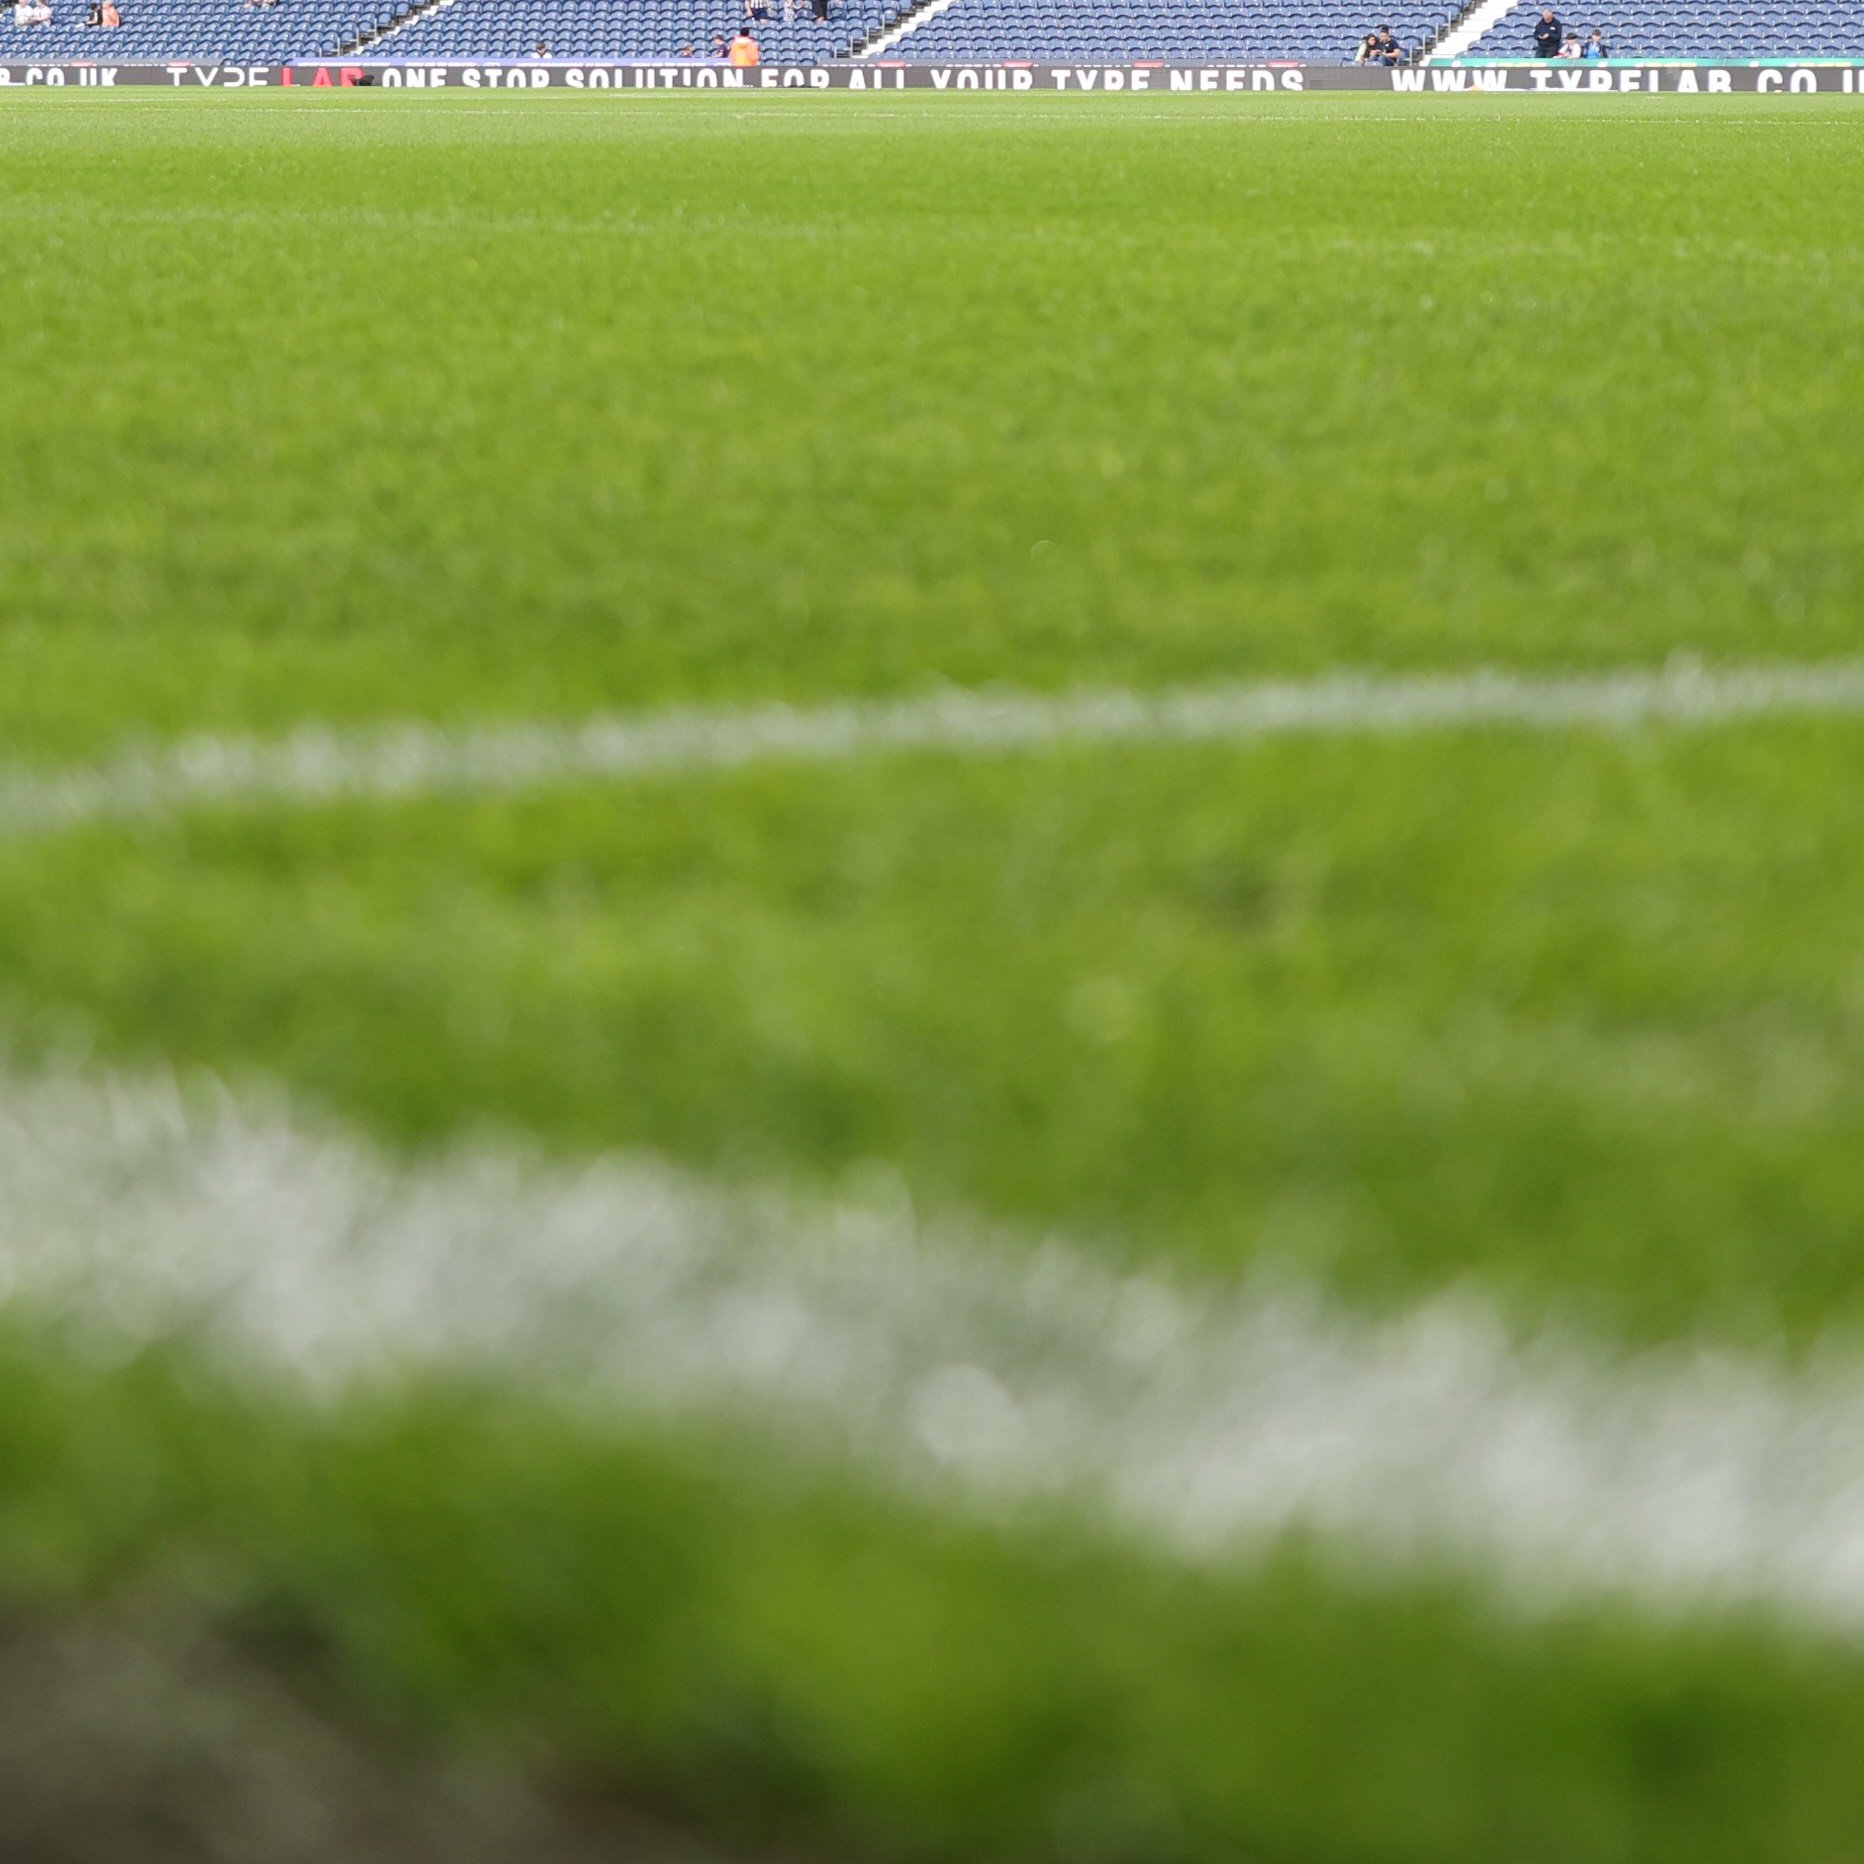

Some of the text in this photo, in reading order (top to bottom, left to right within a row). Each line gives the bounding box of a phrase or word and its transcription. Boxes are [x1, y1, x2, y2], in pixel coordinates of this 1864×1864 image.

[382, 68, 448, 86] ONE
[462, 67, 550, 87] STOP
[761, 68, 830, 88] FOR
[930, 69, 1033, 90] YOUR
[1051, 69, 1150, 90] TYRE
[1171, 69, 1304, 91] NEEDS
